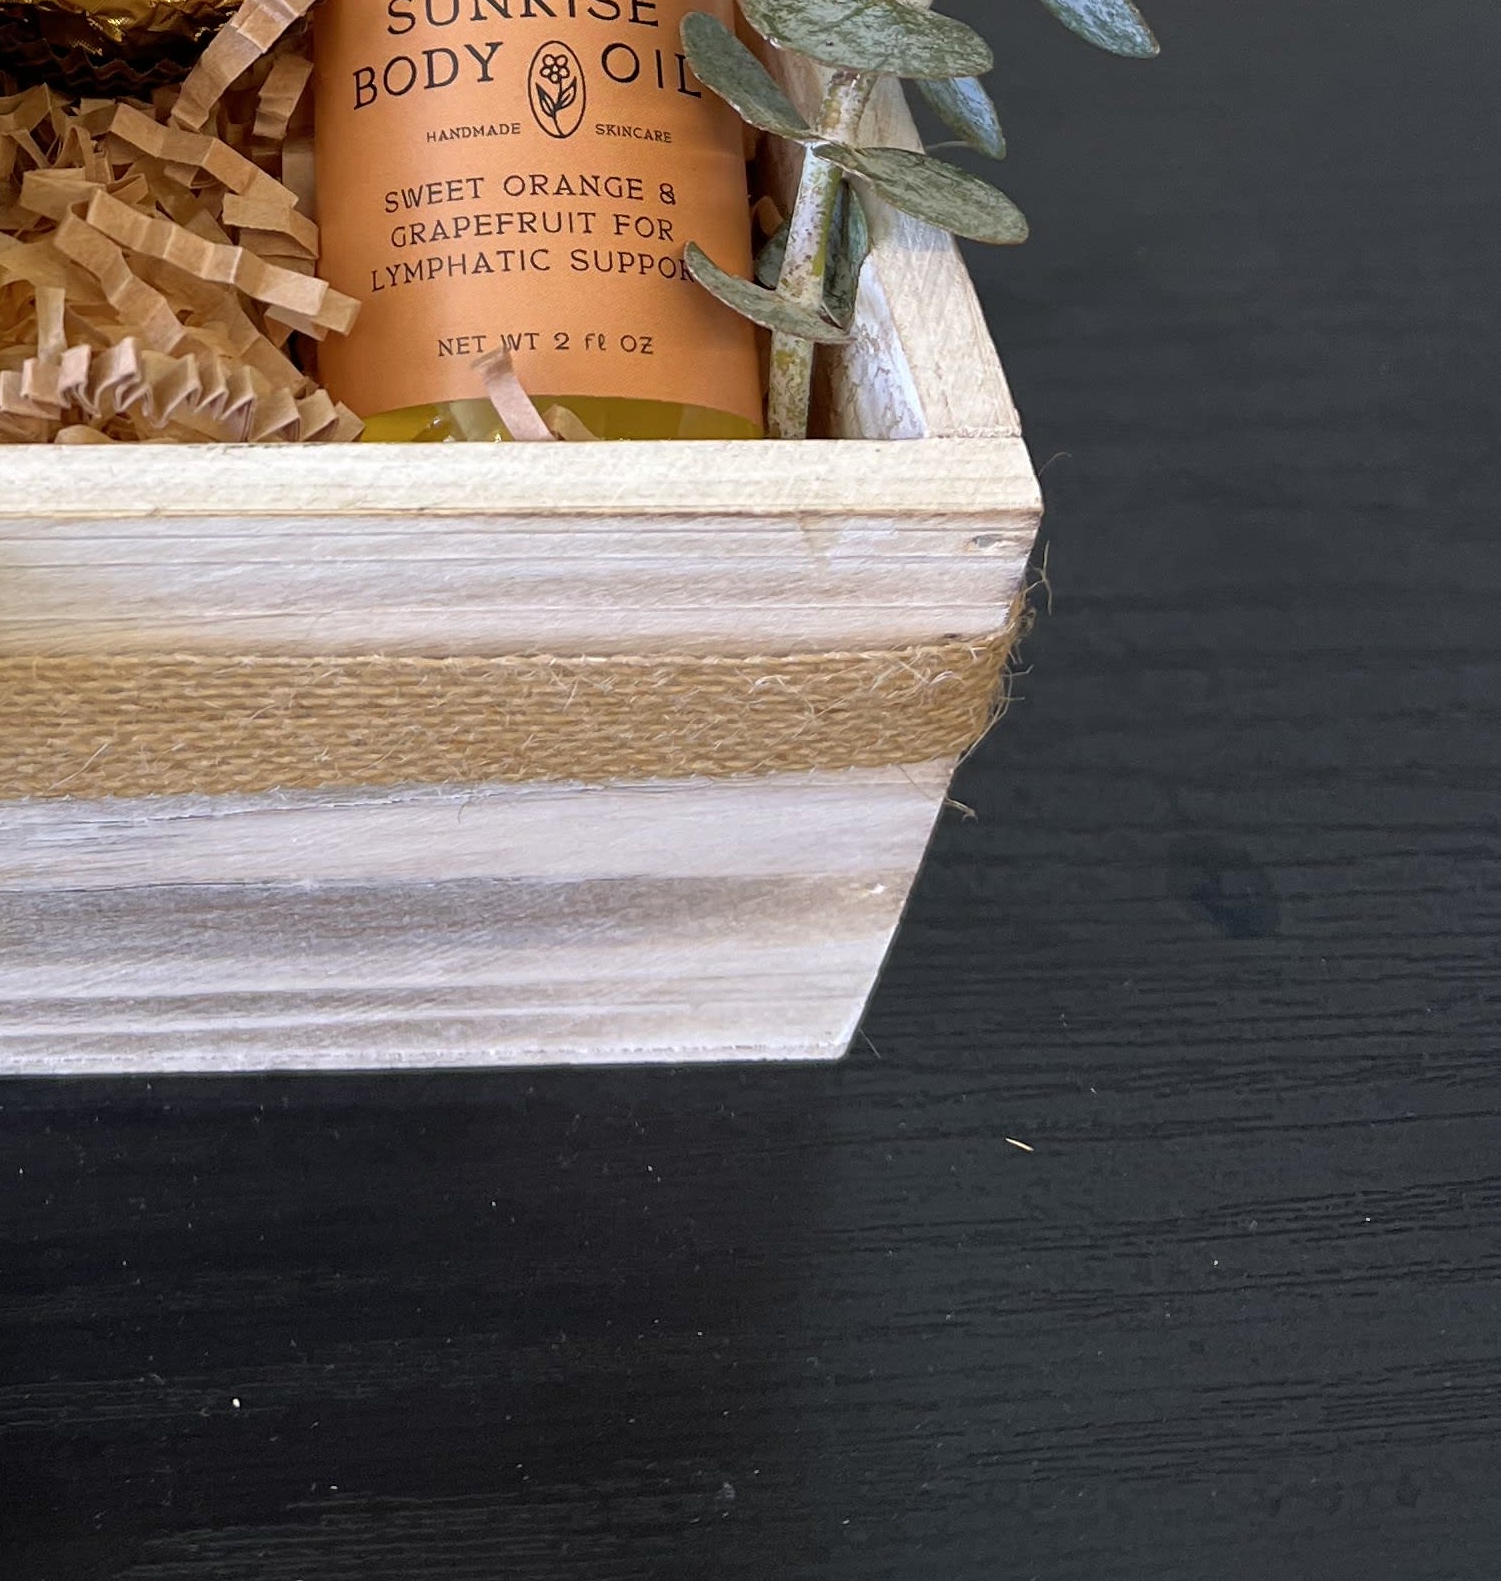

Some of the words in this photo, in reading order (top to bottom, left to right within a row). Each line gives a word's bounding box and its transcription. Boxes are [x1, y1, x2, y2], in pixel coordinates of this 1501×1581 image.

[353, 41, 504, 110] BODY
[601, 42, 701, 98] OIL
[426, 123, 521, 143] HANDMADE
[595, 123, 672, 144] SKINCARE
[384, 177, 484, 213] SWEET
[503, 173, 644, 201] ORANGE
[659, 183, 676, 205] &
[391, 212, 596, 249] GRAPEFRUIT
[613, 215, 674, 242] FOR
[371, 248, 550, 292] LYMPHATIC
[570, 248, 694, 282] SUPPOR
[438, 335, 486, 357] NET
[500, 332, 540, 352] WT
[553, 332, 570, 350] 2
[620, 334, 654, 355] OZ
